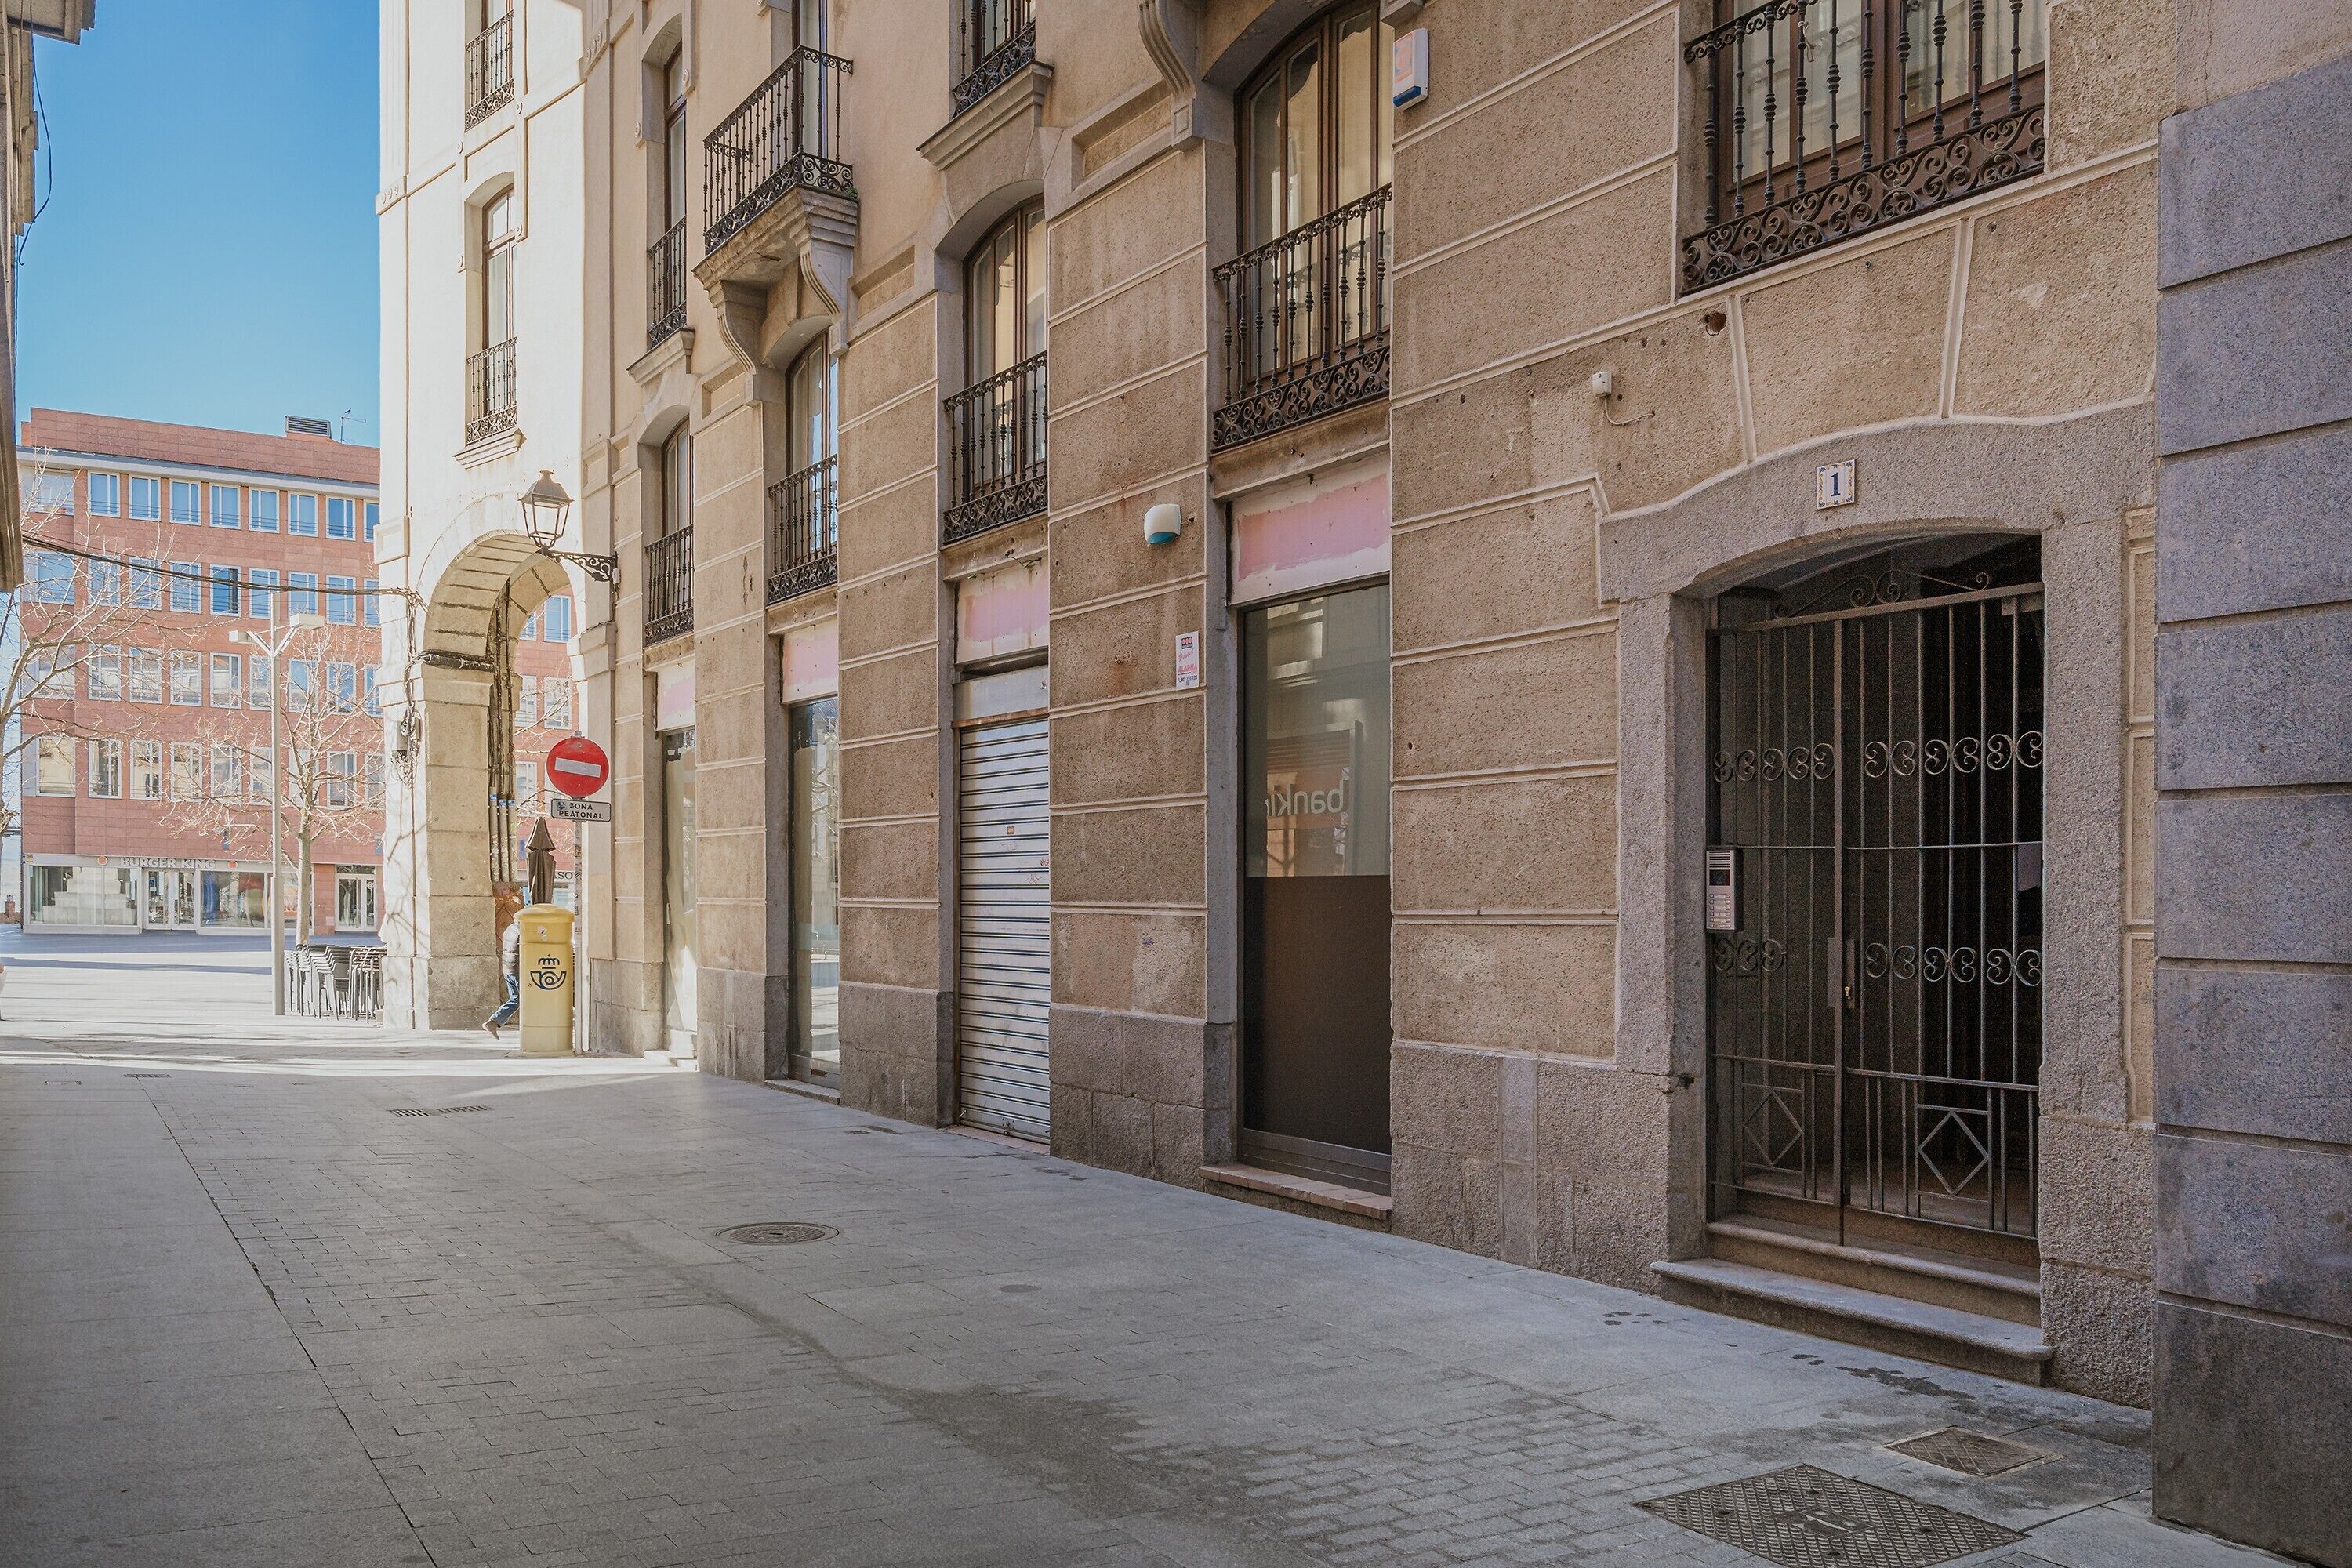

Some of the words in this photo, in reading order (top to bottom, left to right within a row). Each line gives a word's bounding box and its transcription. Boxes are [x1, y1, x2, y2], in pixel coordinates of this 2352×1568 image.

[1831, 472, 1840, 496] 1
[559, 811, 603, 819] PEATONAL
[120, 857, 176, 868] BURGER
[181, 859, 216, 869] KING
